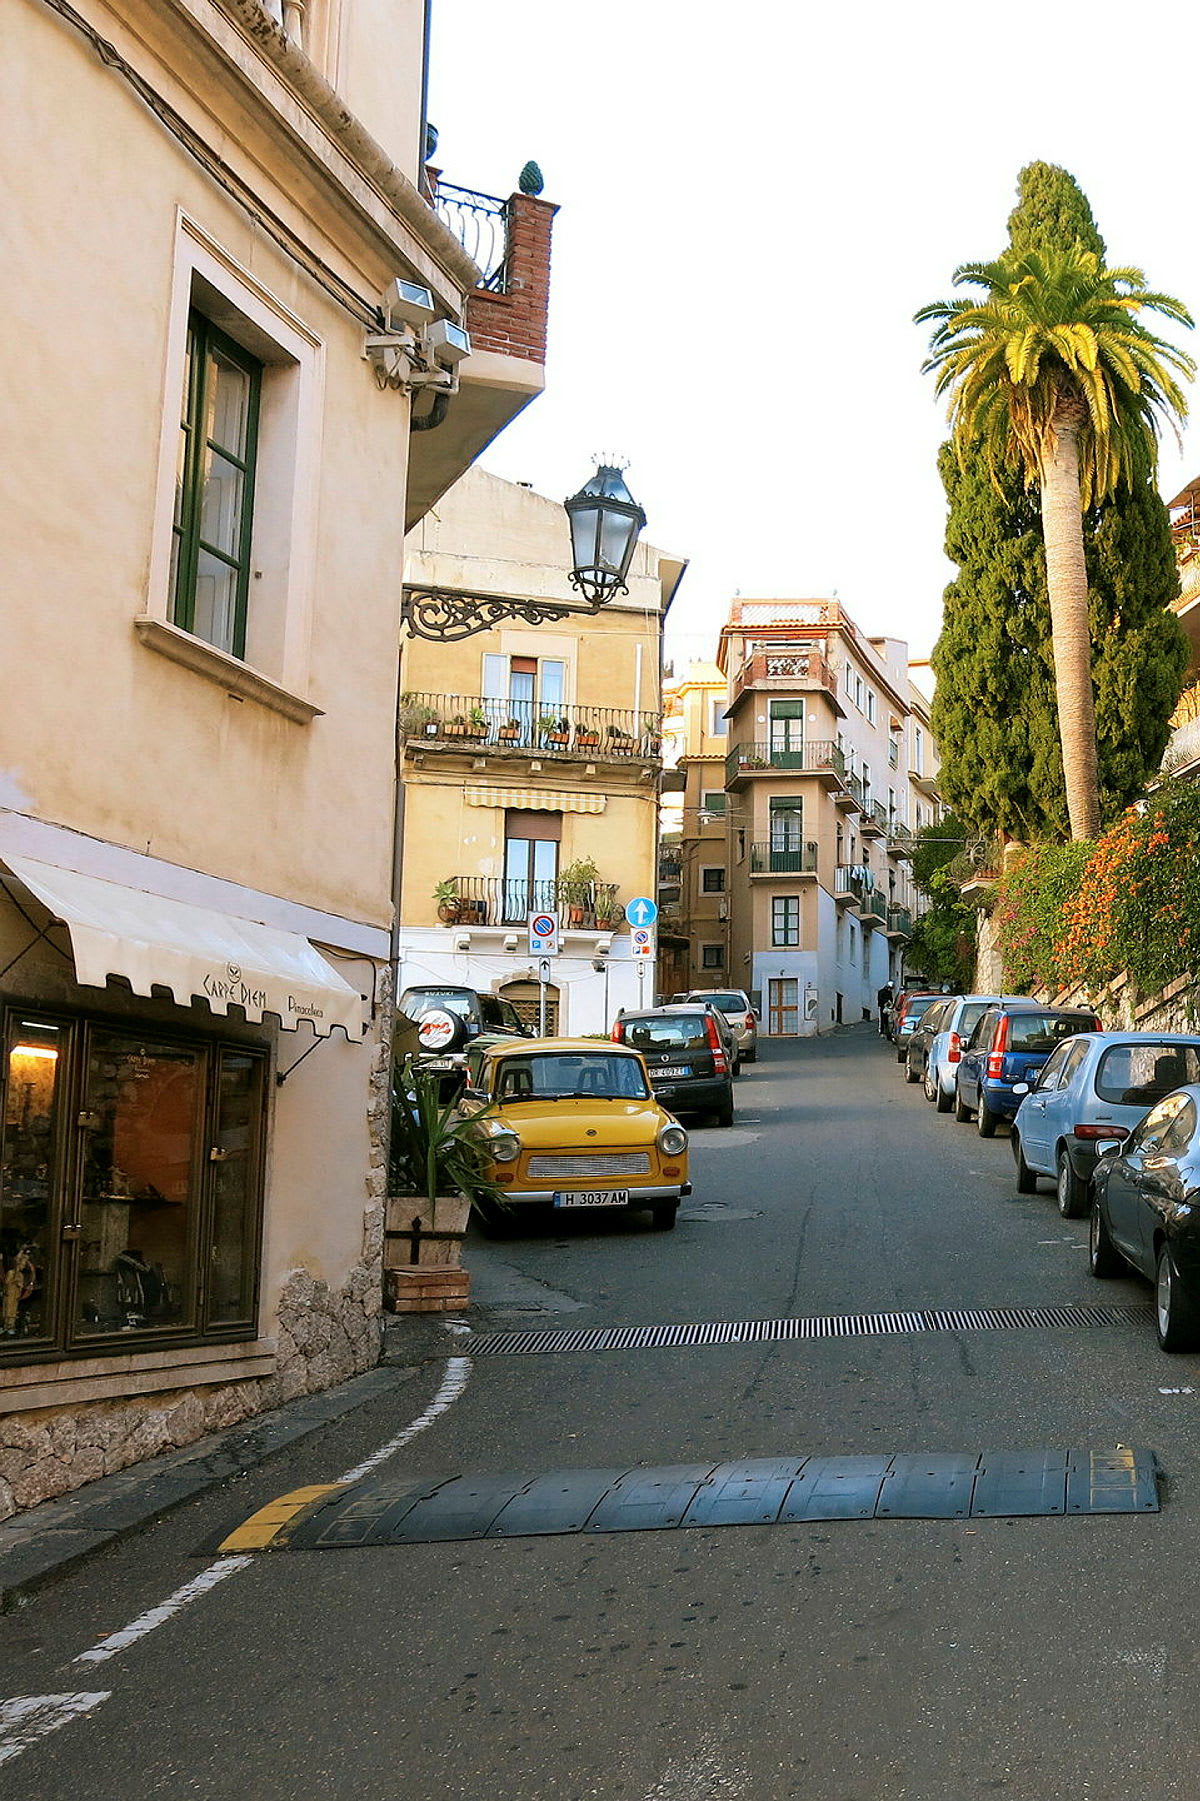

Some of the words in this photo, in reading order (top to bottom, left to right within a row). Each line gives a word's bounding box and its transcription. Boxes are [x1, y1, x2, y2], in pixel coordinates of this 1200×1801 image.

[240, 982, 266, 1009] DIEM
[565, 1195, 574, 1205] H
[580, 1192, 609, 1205] 3037
[611, 1191, 627, 1204] AM
